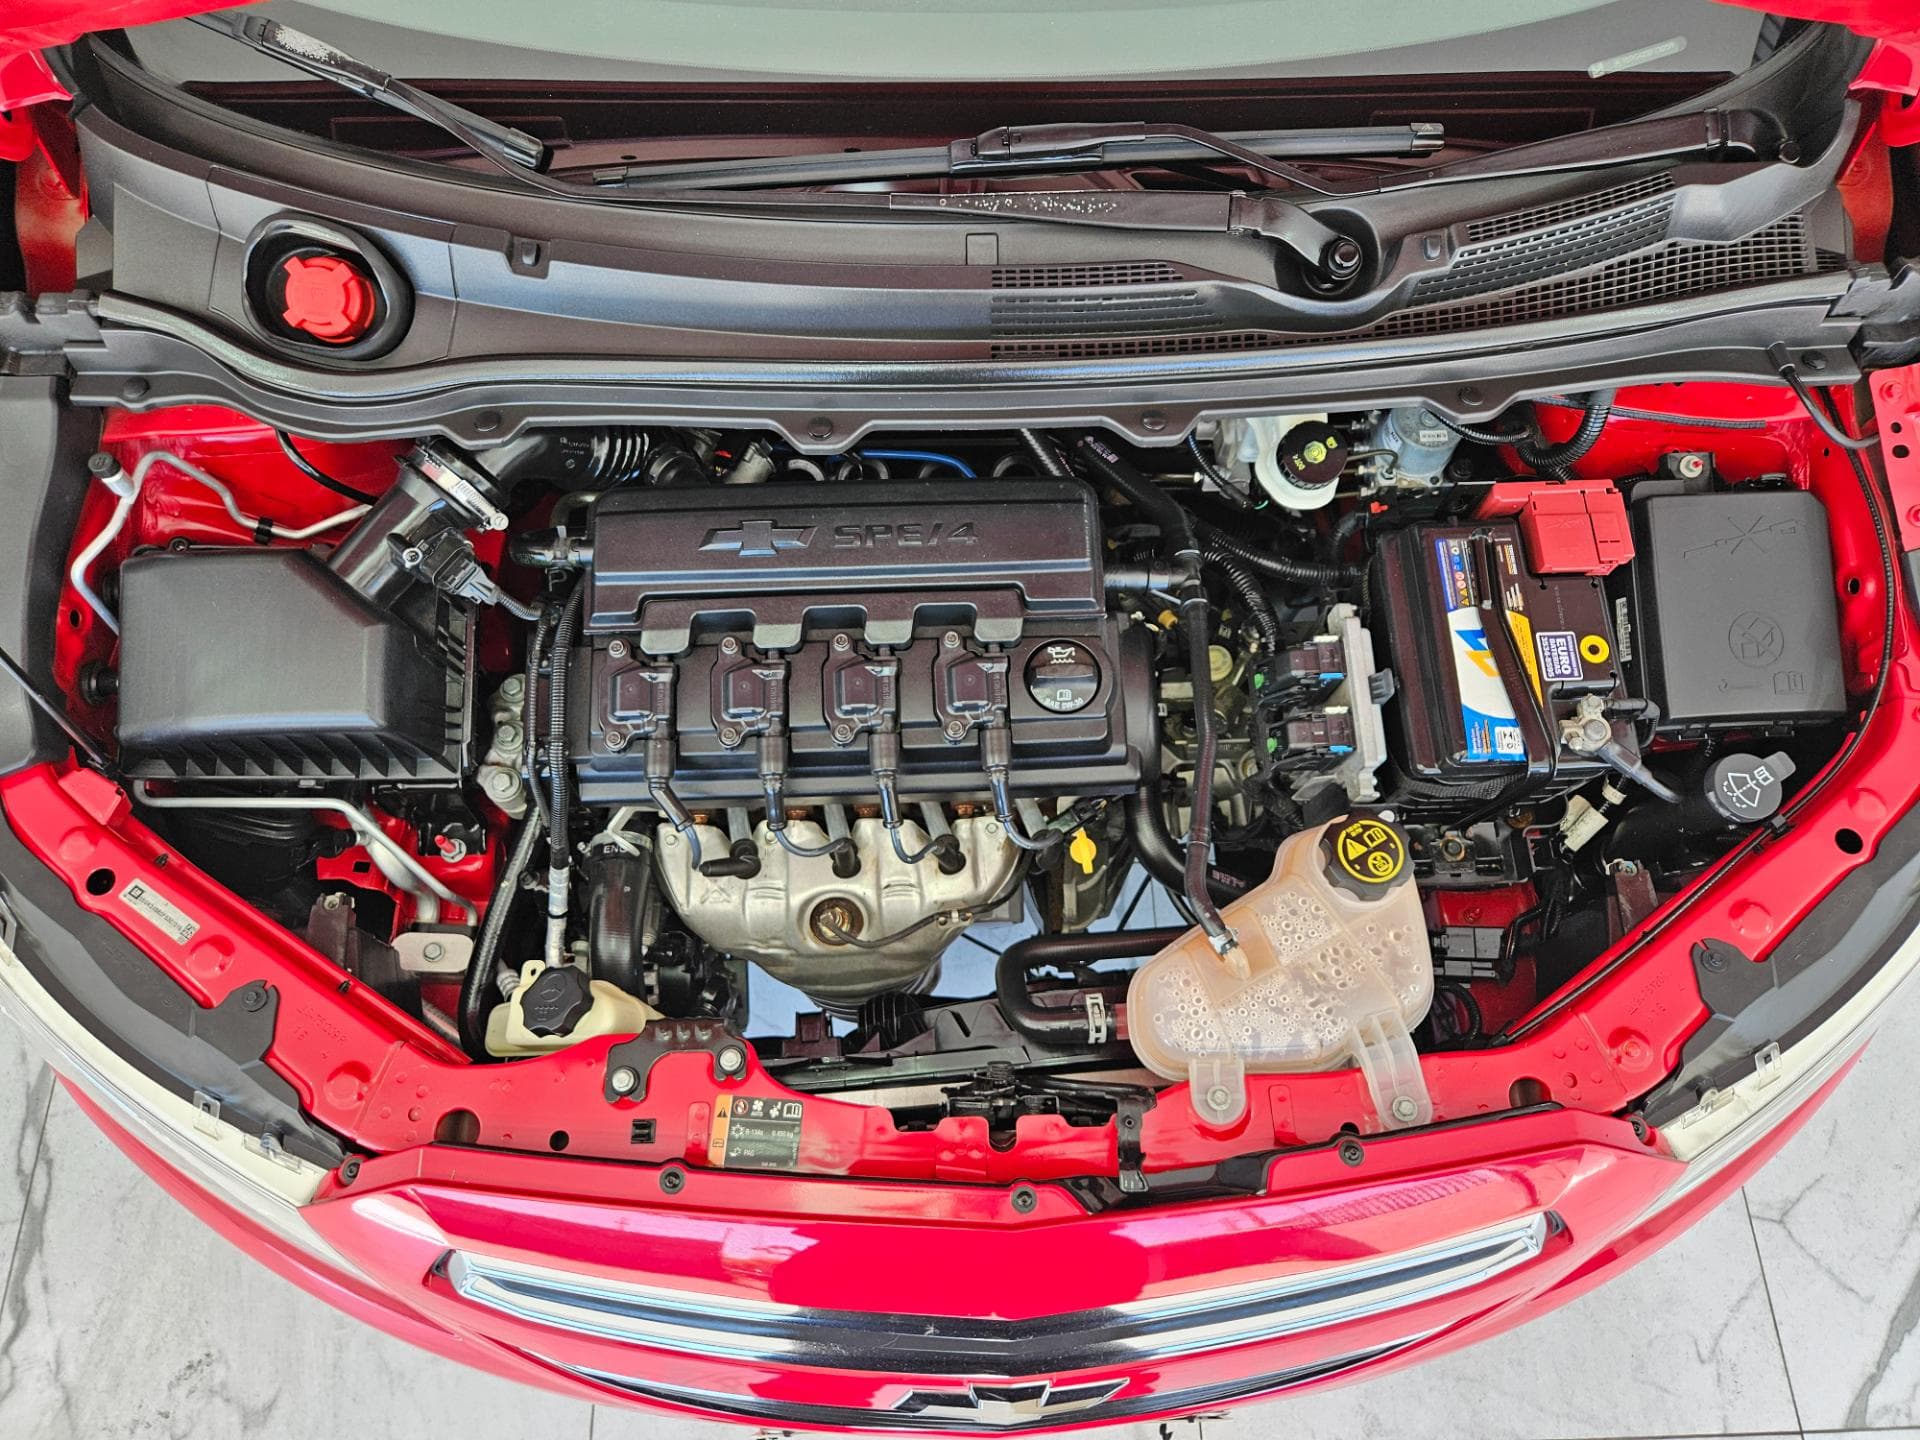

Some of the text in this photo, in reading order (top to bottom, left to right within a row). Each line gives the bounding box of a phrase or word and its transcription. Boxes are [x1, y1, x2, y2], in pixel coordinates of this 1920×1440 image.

[834, 521, 979, 549] SPE/4
[1549, 639, 1562, 675] BATERIAS
[1556, 638, 1572, 675] EURO
